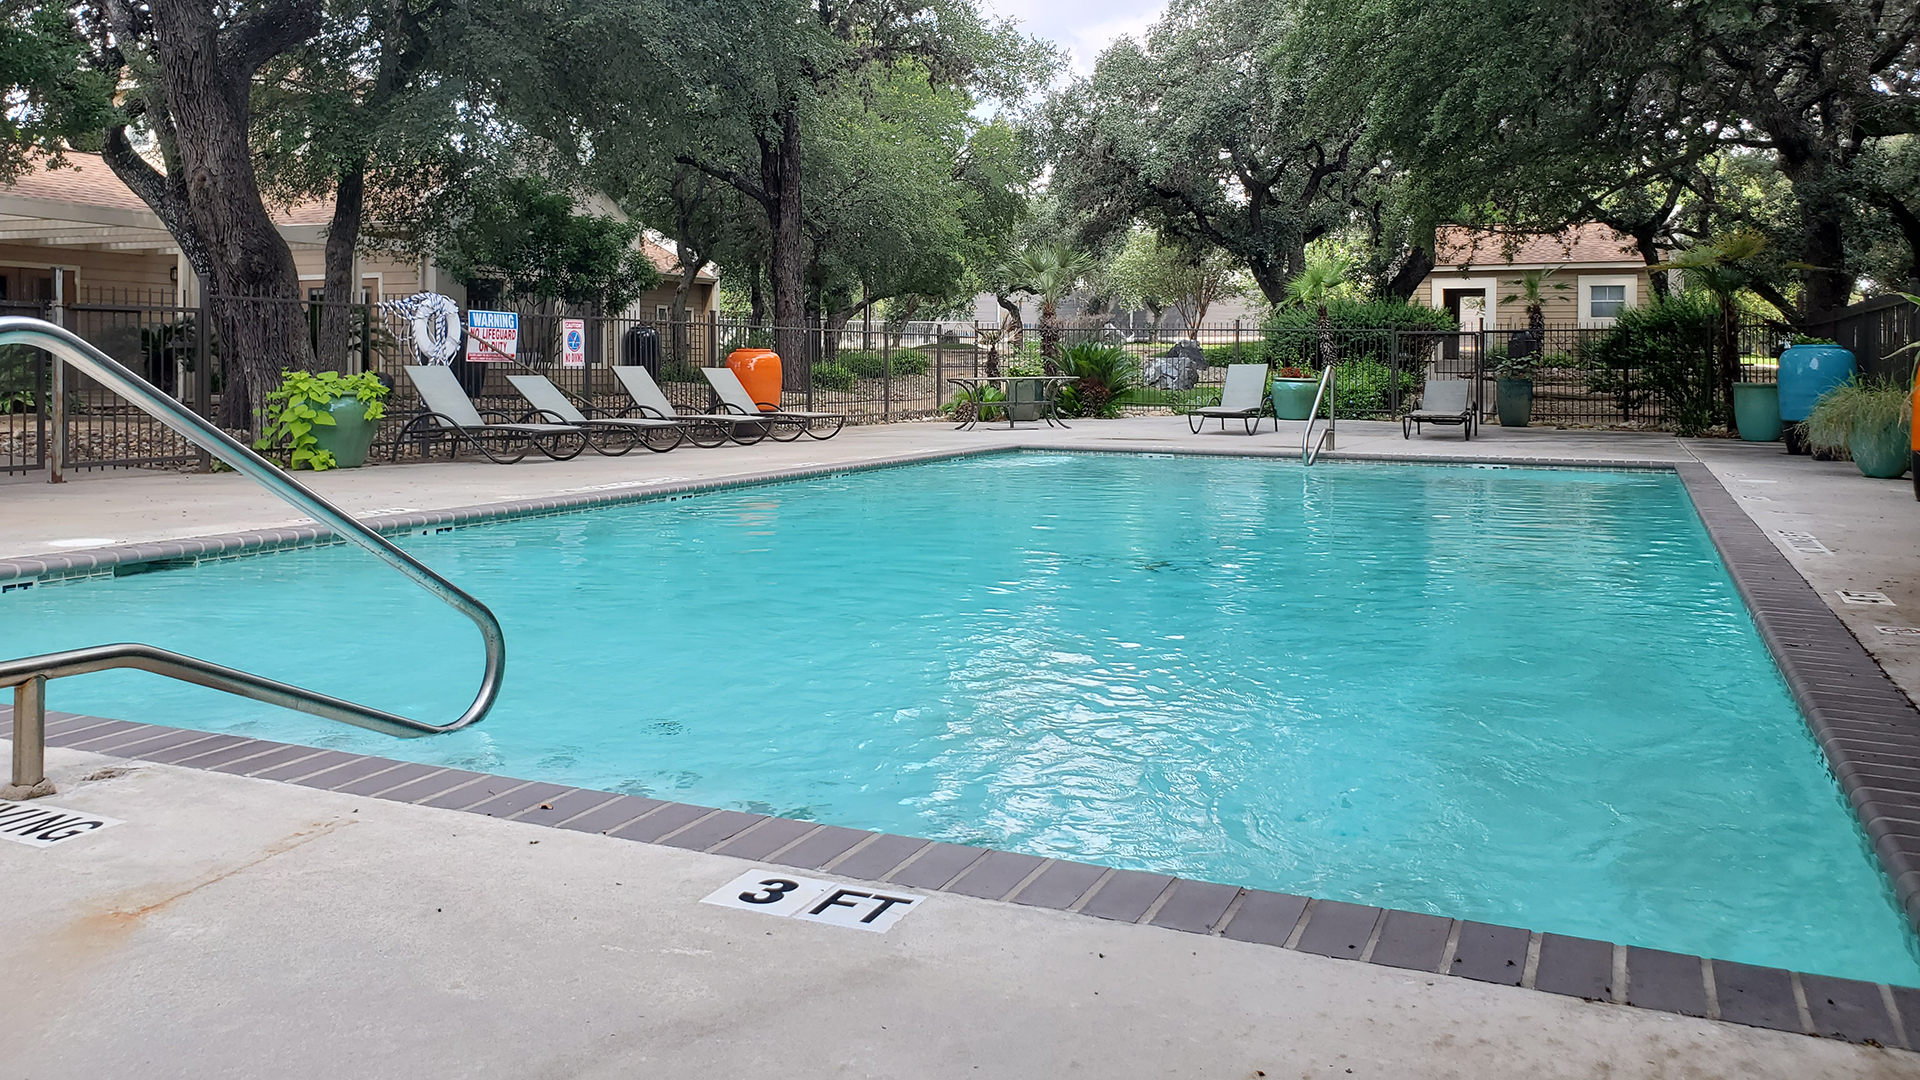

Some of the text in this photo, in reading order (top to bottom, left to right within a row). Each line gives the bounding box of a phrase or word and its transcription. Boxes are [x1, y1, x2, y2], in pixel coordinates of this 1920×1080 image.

[472, 312, 515, 328] WARNING
[470, 328, 517, 340] NO LIFEGUARD
[478, 341, 508, 352] ON DUTY
[565, 353, 571, 363] NO
[738, 878, 915, 924] 3 FT
